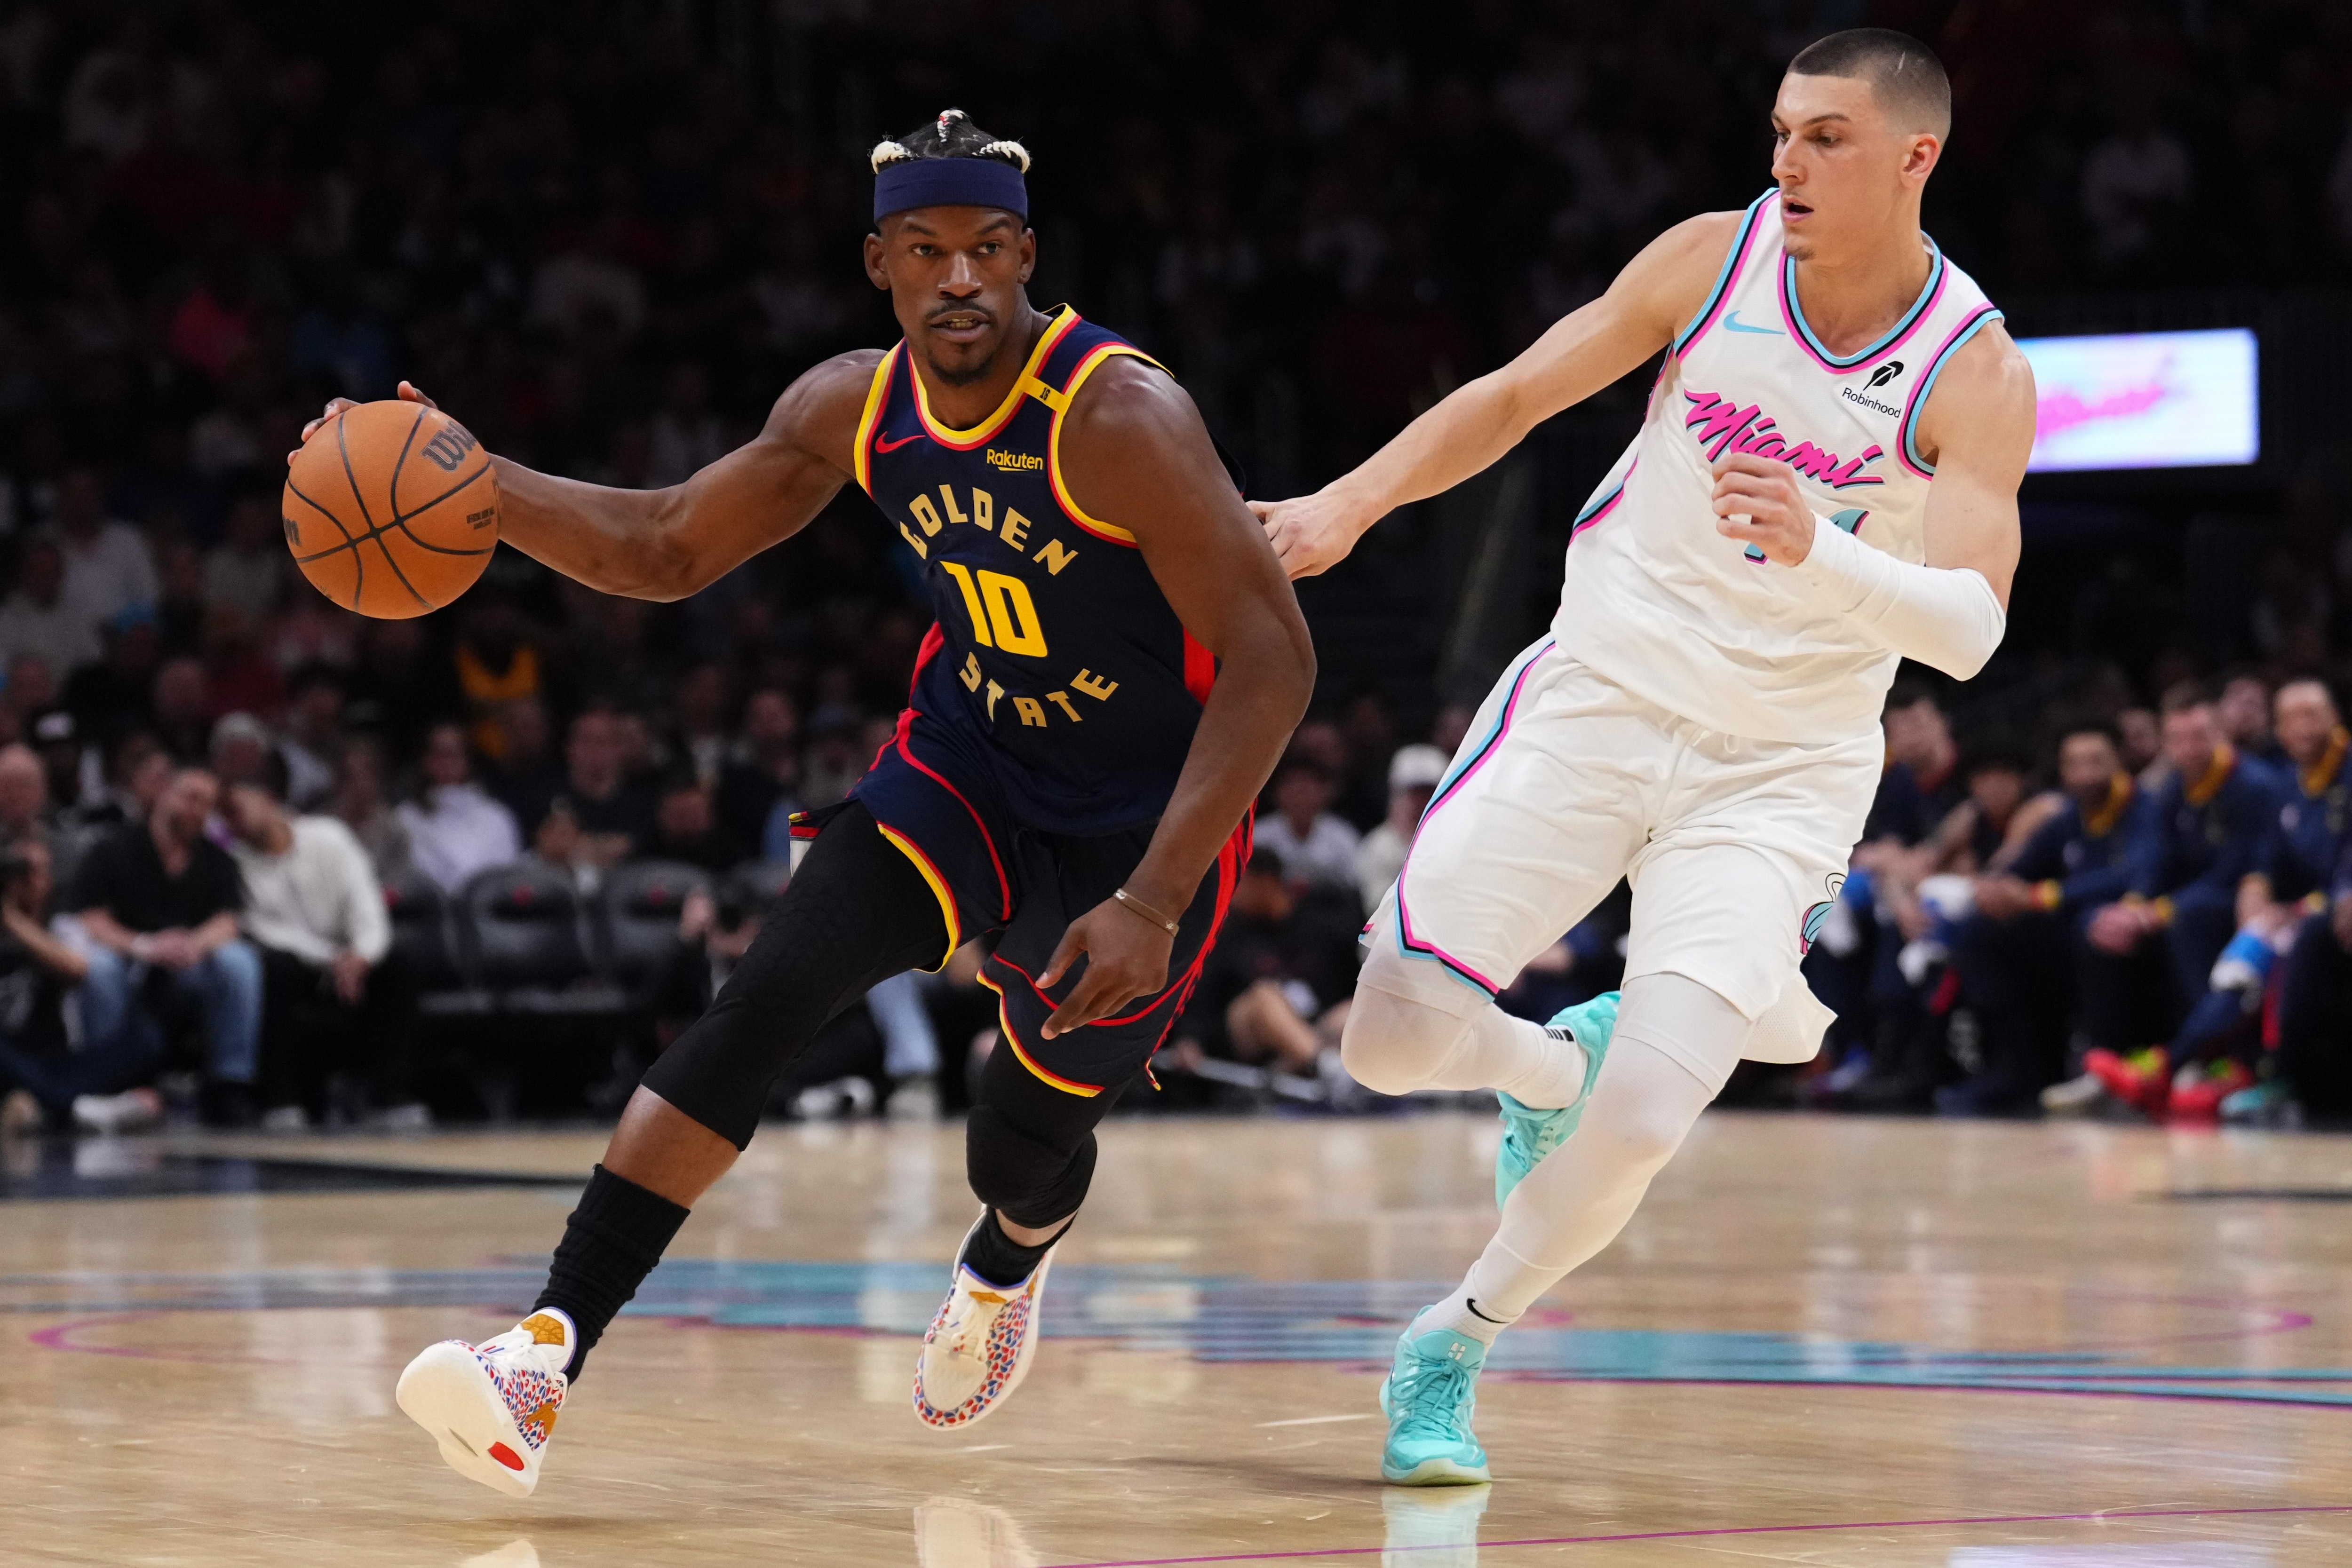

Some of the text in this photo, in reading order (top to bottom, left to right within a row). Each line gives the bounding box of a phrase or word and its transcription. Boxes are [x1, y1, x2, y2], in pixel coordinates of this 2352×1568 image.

[1040, 387, 1050, 401] 16
[1842, 387, 1901, 419] Robinhood
[986, 448, 1044, 470] Rakuten
[1684, 388, 1885, 491] Miami
[939, 560, 1048, 657] 10
[959, 652, 1119, 727] STATE
